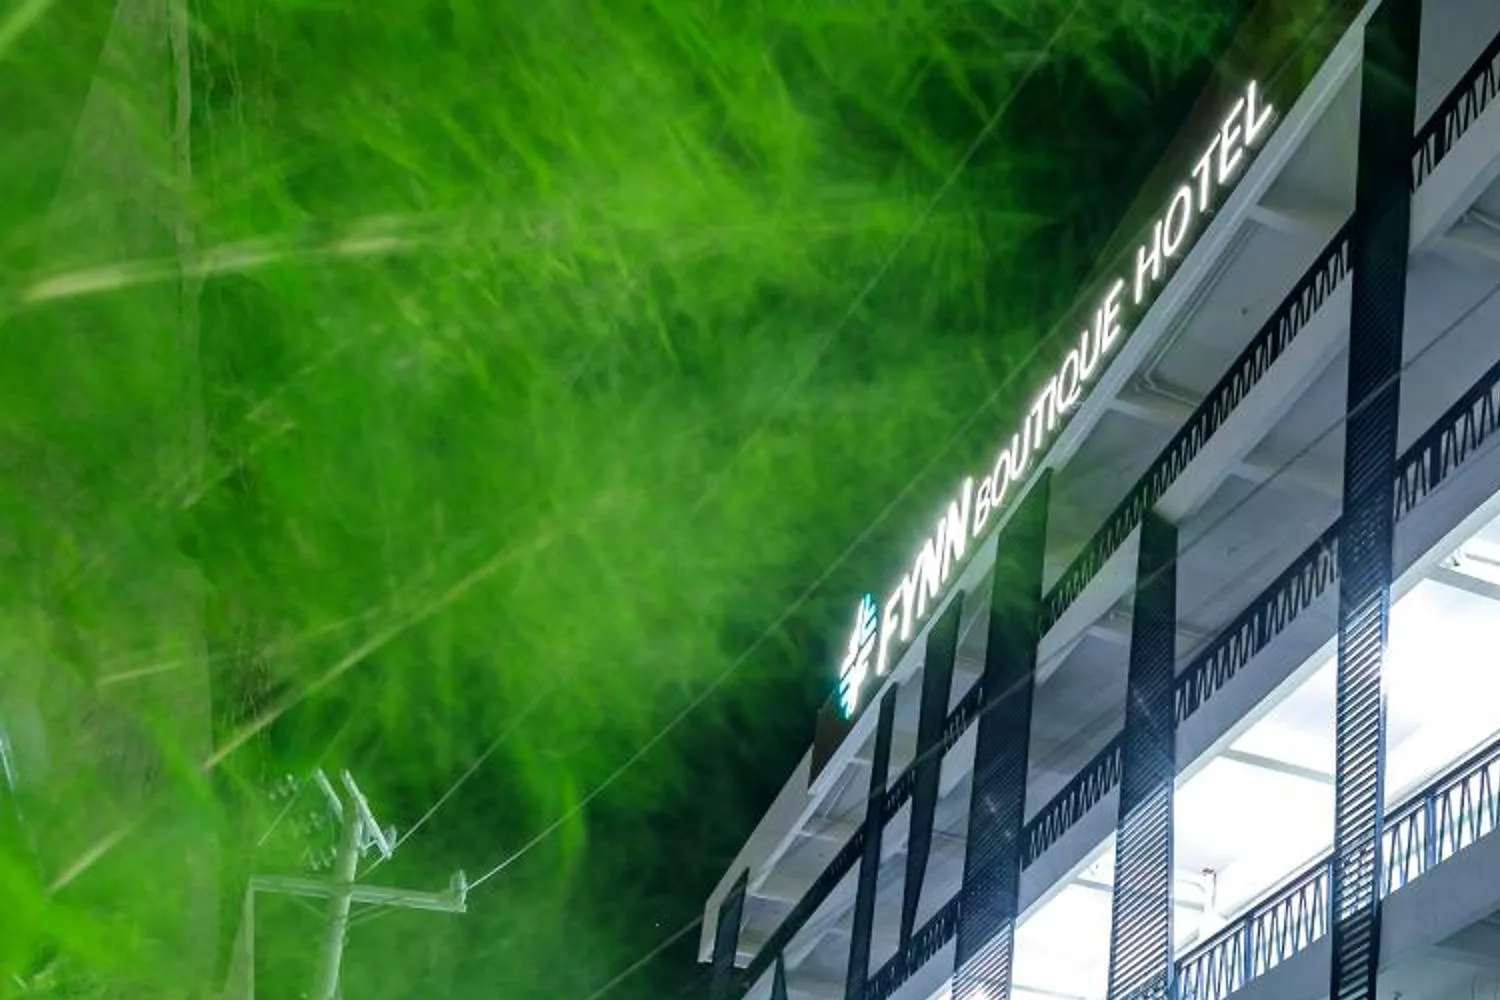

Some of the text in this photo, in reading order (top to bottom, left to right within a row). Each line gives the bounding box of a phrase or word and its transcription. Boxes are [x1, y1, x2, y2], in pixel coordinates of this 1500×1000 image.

[875, 79, 1274, 677] FYNN BOUTIQUE HOTEL
